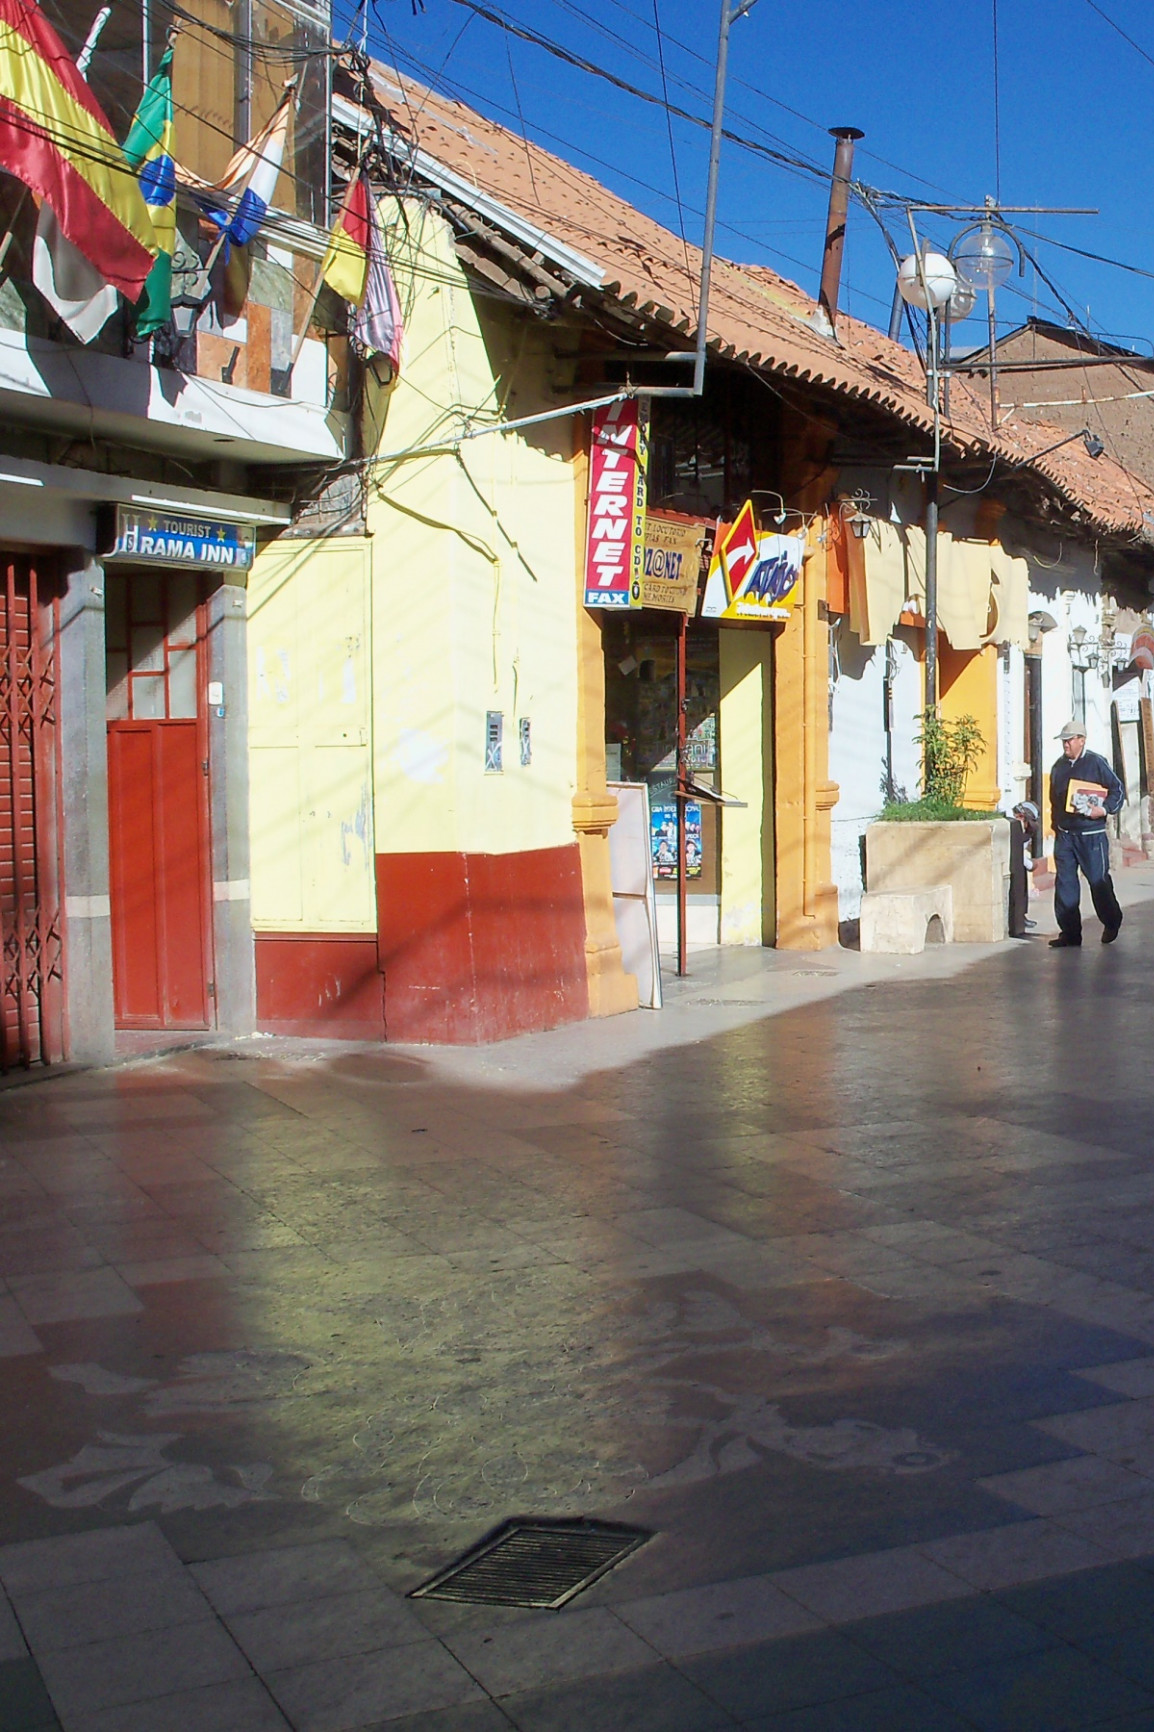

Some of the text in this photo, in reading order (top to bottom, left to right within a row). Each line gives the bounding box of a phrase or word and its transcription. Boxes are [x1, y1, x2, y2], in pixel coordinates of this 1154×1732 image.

[591, 400, 633, 587] INTERNET
[163, 519, 212, 539] TOURIST
[634, 515, 643, 537] TO
[140, 536, 234, 565] RAMA INN
[587, 591, 626, 604] FAX
